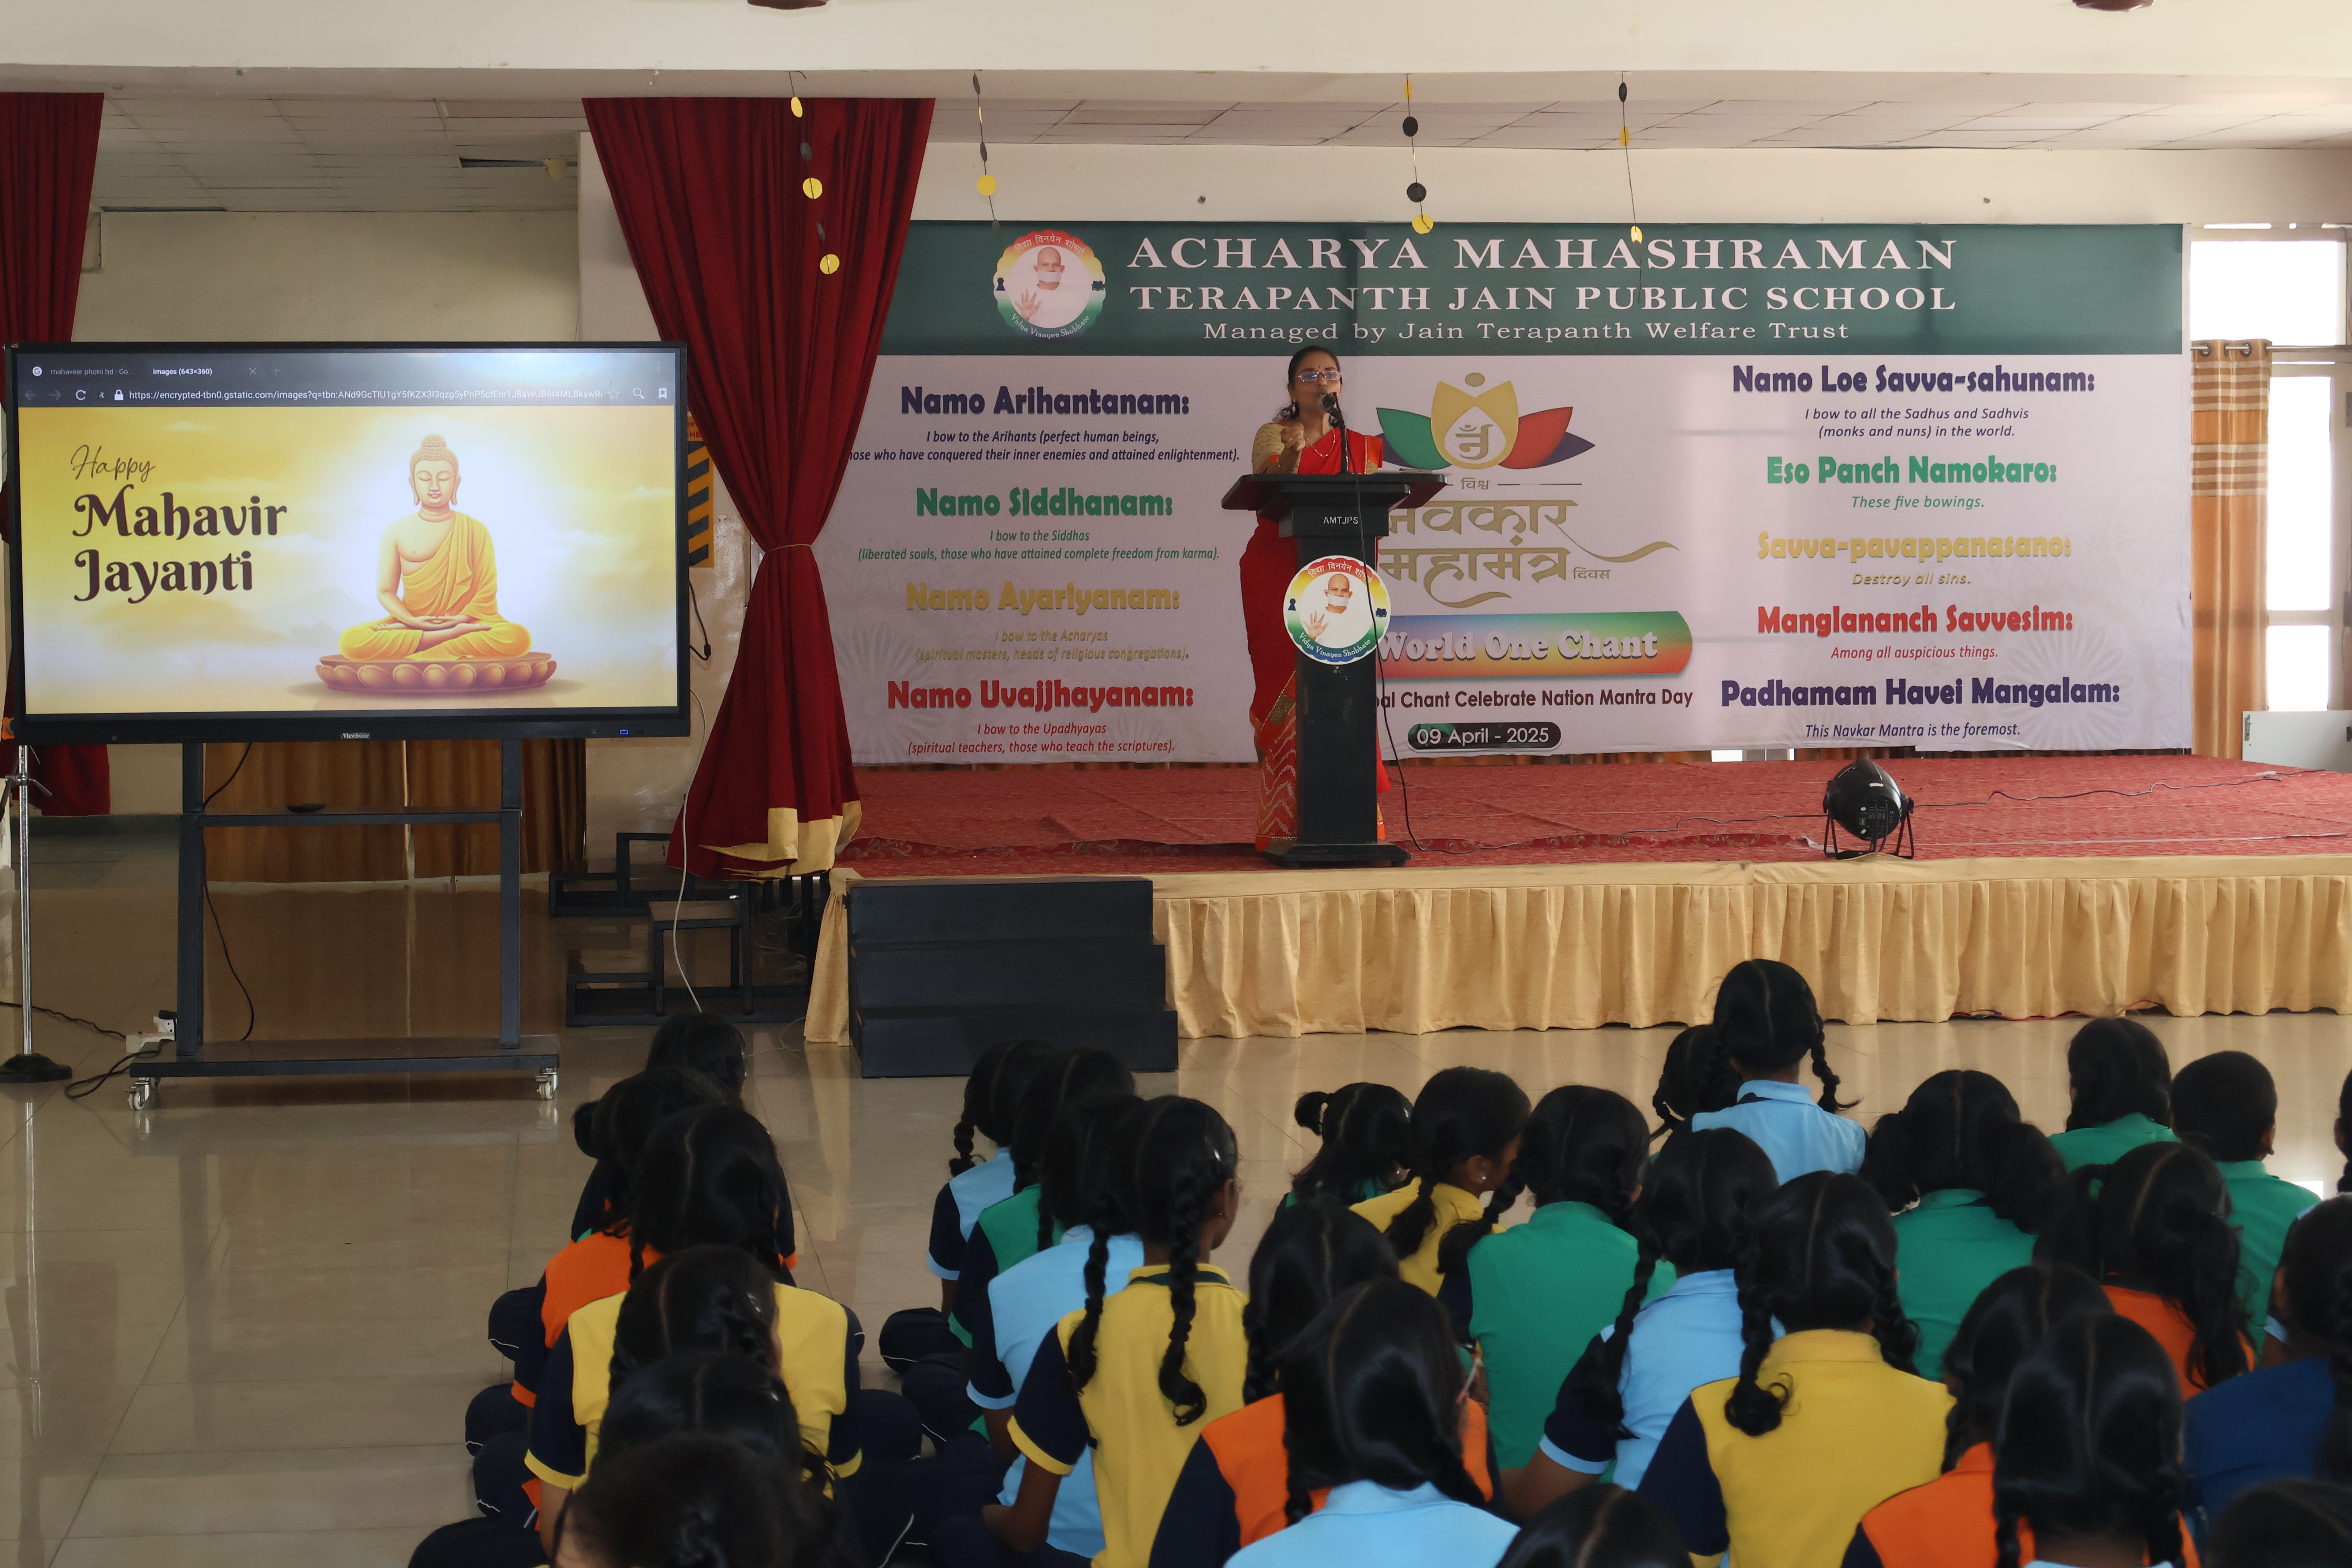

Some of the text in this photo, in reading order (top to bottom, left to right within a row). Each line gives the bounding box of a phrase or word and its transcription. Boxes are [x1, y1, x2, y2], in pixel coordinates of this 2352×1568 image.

[1127, 238, 1956, 269] ACHARYA MAHASHRAMAN
[1130, 287, 1955, 310] TERAPANTH JAIN PUBLIC SCHOOL
[1011, 313, 1090, 339] Vidya Vinayen Shobhate
[1204, 322, 1848, 343] Managed by Jain Terapanth Welfare Trust
[1733, 365, 2094, 392] Namo Loe Savva-sahunam:
[902, 386, 1189, 414] Namo Arihantanam:
[1806, 408, 2029, 419] I bow to all the Sadhus and Sadhvis
[927, 430, 1158, 445] I bow to the Arihants (perfect human beings,
[1819, 425, 2014, 439] (monks and nuns) in the world.
[71, 445, 156, 483] Happy
[875, 448, 896, 460] who
[899, 449, 924, 460] have
[927, 448, 982, 462] conquered
[986, 448, 1011, 460] their
[1013, 449, 1040, 460] inner
[1043, 449, 1086, 460] enemies
[1089, 449, 1109, 460] and
[1112, 449, 1155, 460] attained
[1158, 448, 1239, 463] enlightenment).
[1768, 455, 2056, 484] Eso Panch Namokaro:
[1461, 477, 1490, 490] विश्व
[916, 487, 1172, 516] Namo Siddhanam:
[1852, 495, 1984, 510] These five bowings.
[72, 484, 287, 540] Mahavir
[1323, 516, 1358, 524] AMTJPS
[990, 530, 1089, 541] I bow to the Siddhas
[858, 547, 1219, 562] (liberated souls, those who have attained complete freedom from karma).
[1758, 531, 2071, 563] Savva-pavappanasano:
[74, 549, 252, 604] Jayanti
[1308, 565, 1325, 577] विद्या
[1328, 561, 1352, 572] विनयेन
[1572, 567, 1611, 579] दिवस
[1852, 573, 1970, 587] Destroy all sins.
[907, 581, 1180, 614] Namo Ayariyanam:
[1759, 604, 2073, 637] Manglananch Savvesim:
[995, 629, 1108, 644] I bow to the Acharyas
[1299, 632, 1371, 659] Vidya Vinayen Shobhate
[1379, 629, 1657, 662] World One Chant
[916, 647, 1189, 662] (spiritual masters, heads of religious congregations).
[1831, 645, 1998, 661] Among all auspicious things.
[888, 679, 1193, 713] Namo Uvajjhayanam:
[1401, 691, 1450, 708] Chant
[1455, 690, 1536, 707] Celebrate
[1542, 690, 1593, 706] Nation
[1600, 689, 1655, 705] Mantra
[1662, 689, 1693, 708] Day
[1722, 677, 2119, 708] Padhamam Havei Mangalam:
[978, 722, 1106, 736] I bow to the Upadhyayas
[1417, 728, 1441, 744] 09
[1448, 728, 1488, 746] April
[1507, 728, 1548, 742] 2025
[1806, 722, 2020, 739] This Navkar Mantra is the foremost.
[908, 740, 1174, 755] (spiritual teachers, those who teach the scriptures).
